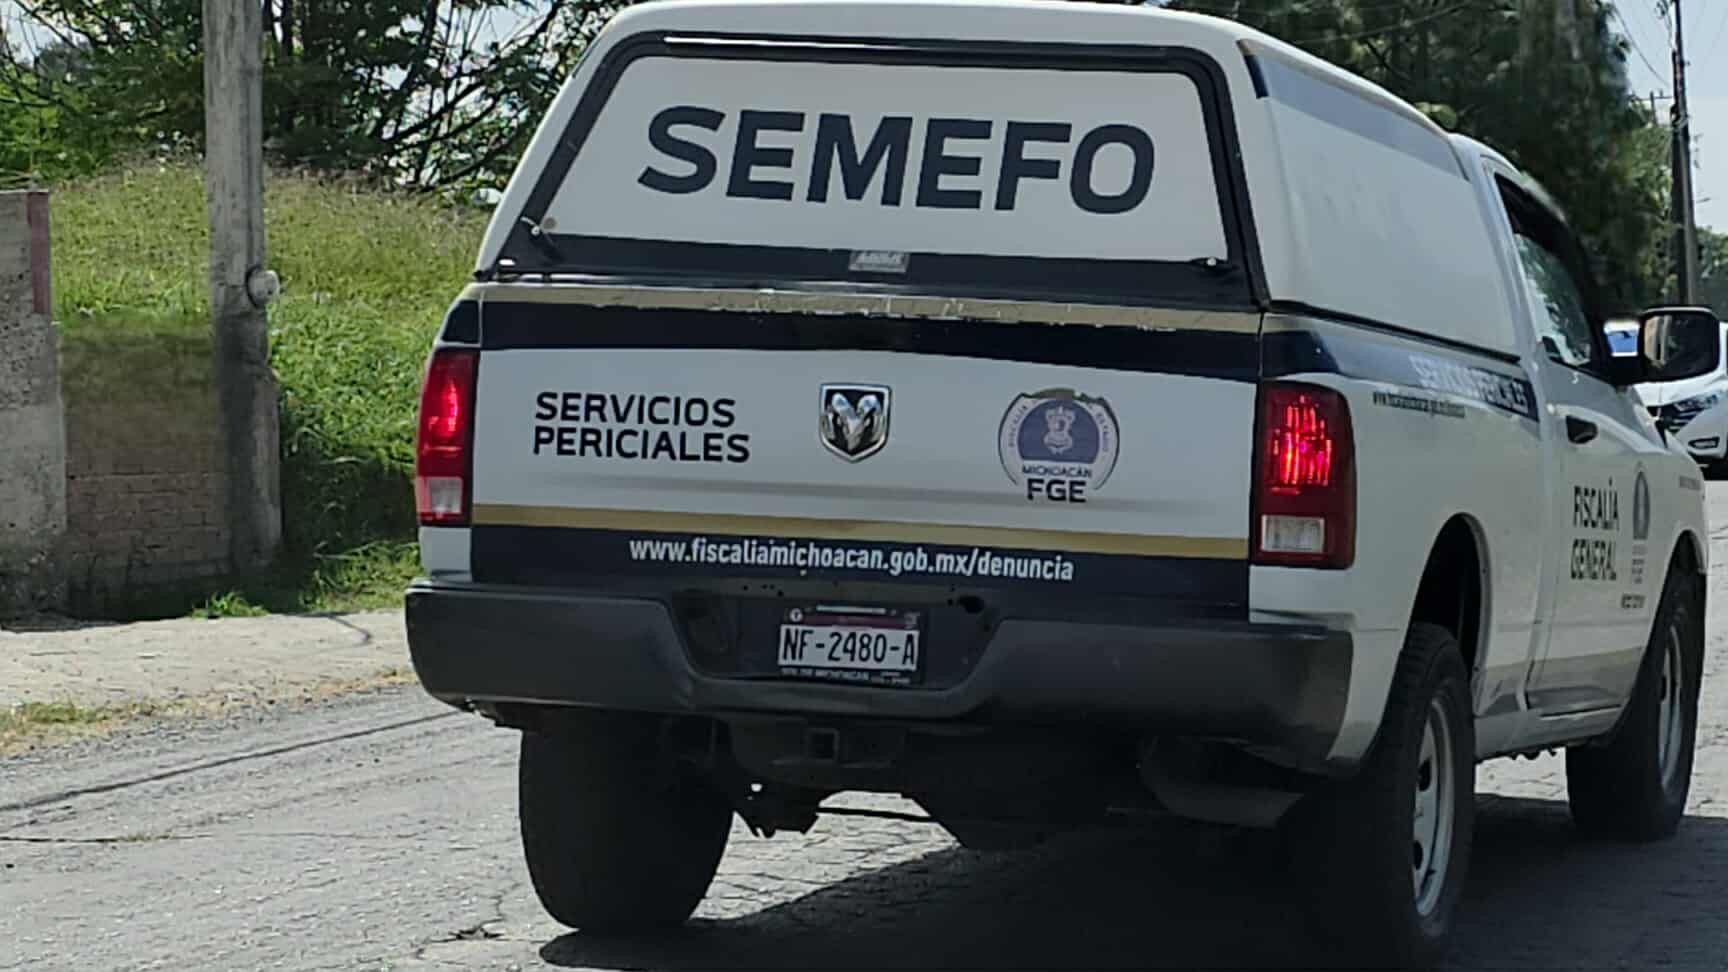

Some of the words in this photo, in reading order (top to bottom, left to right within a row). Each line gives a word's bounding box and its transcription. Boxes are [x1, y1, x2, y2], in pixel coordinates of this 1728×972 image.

[637, 105, 1155, 214] SEMEFO
[534, 391, 736, 428] SERVICIOS
[533, 426, 750, 463] PERICIALES
[1027, 478, 1087, 503] FGE
[629, 537, 1075, 582] www.fiscaliamichoacan.gob.mx/denuncia
[781, 628, 915, 665] NF-2480-A
